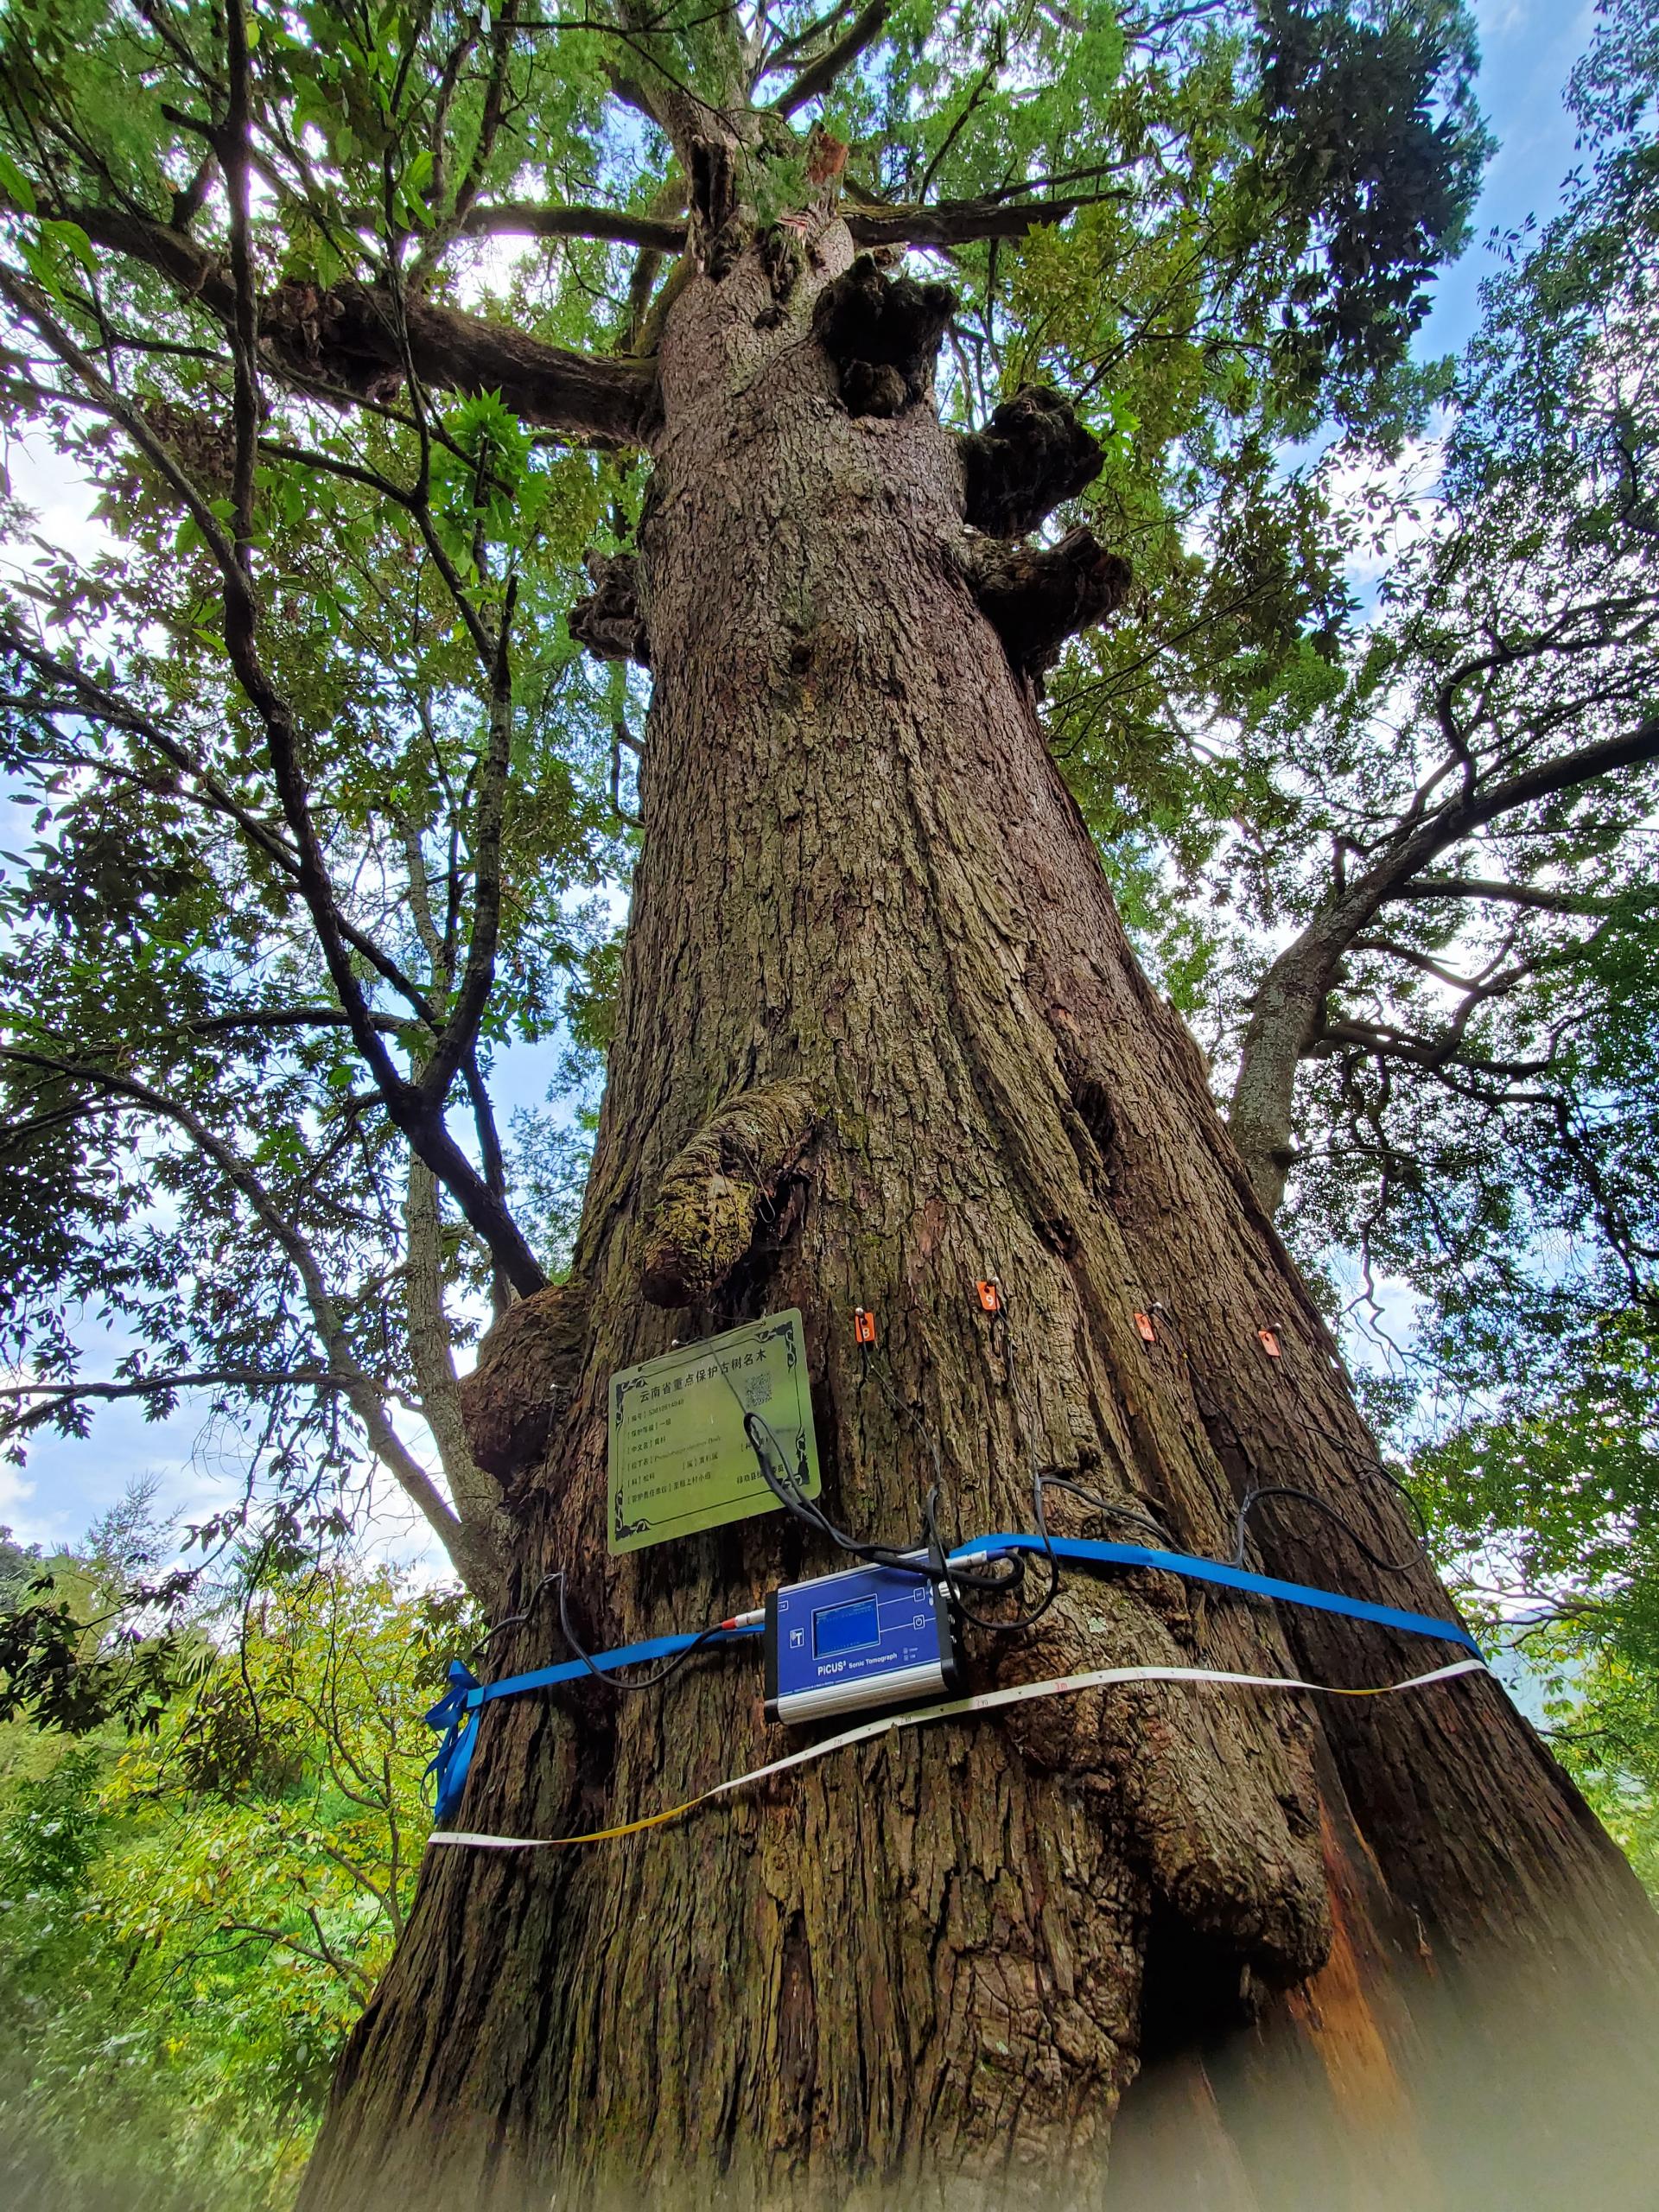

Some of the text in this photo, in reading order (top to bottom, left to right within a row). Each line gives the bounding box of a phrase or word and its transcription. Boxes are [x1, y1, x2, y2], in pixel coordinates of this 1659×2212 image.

[986, 1295, 994, 1306] 9
[639, 1348, 767, 1403] 云南省重点保护古树名木
[849, 1661, 864, 1669] Sonic
[866, 1652, 898, 1666] Tomograph
